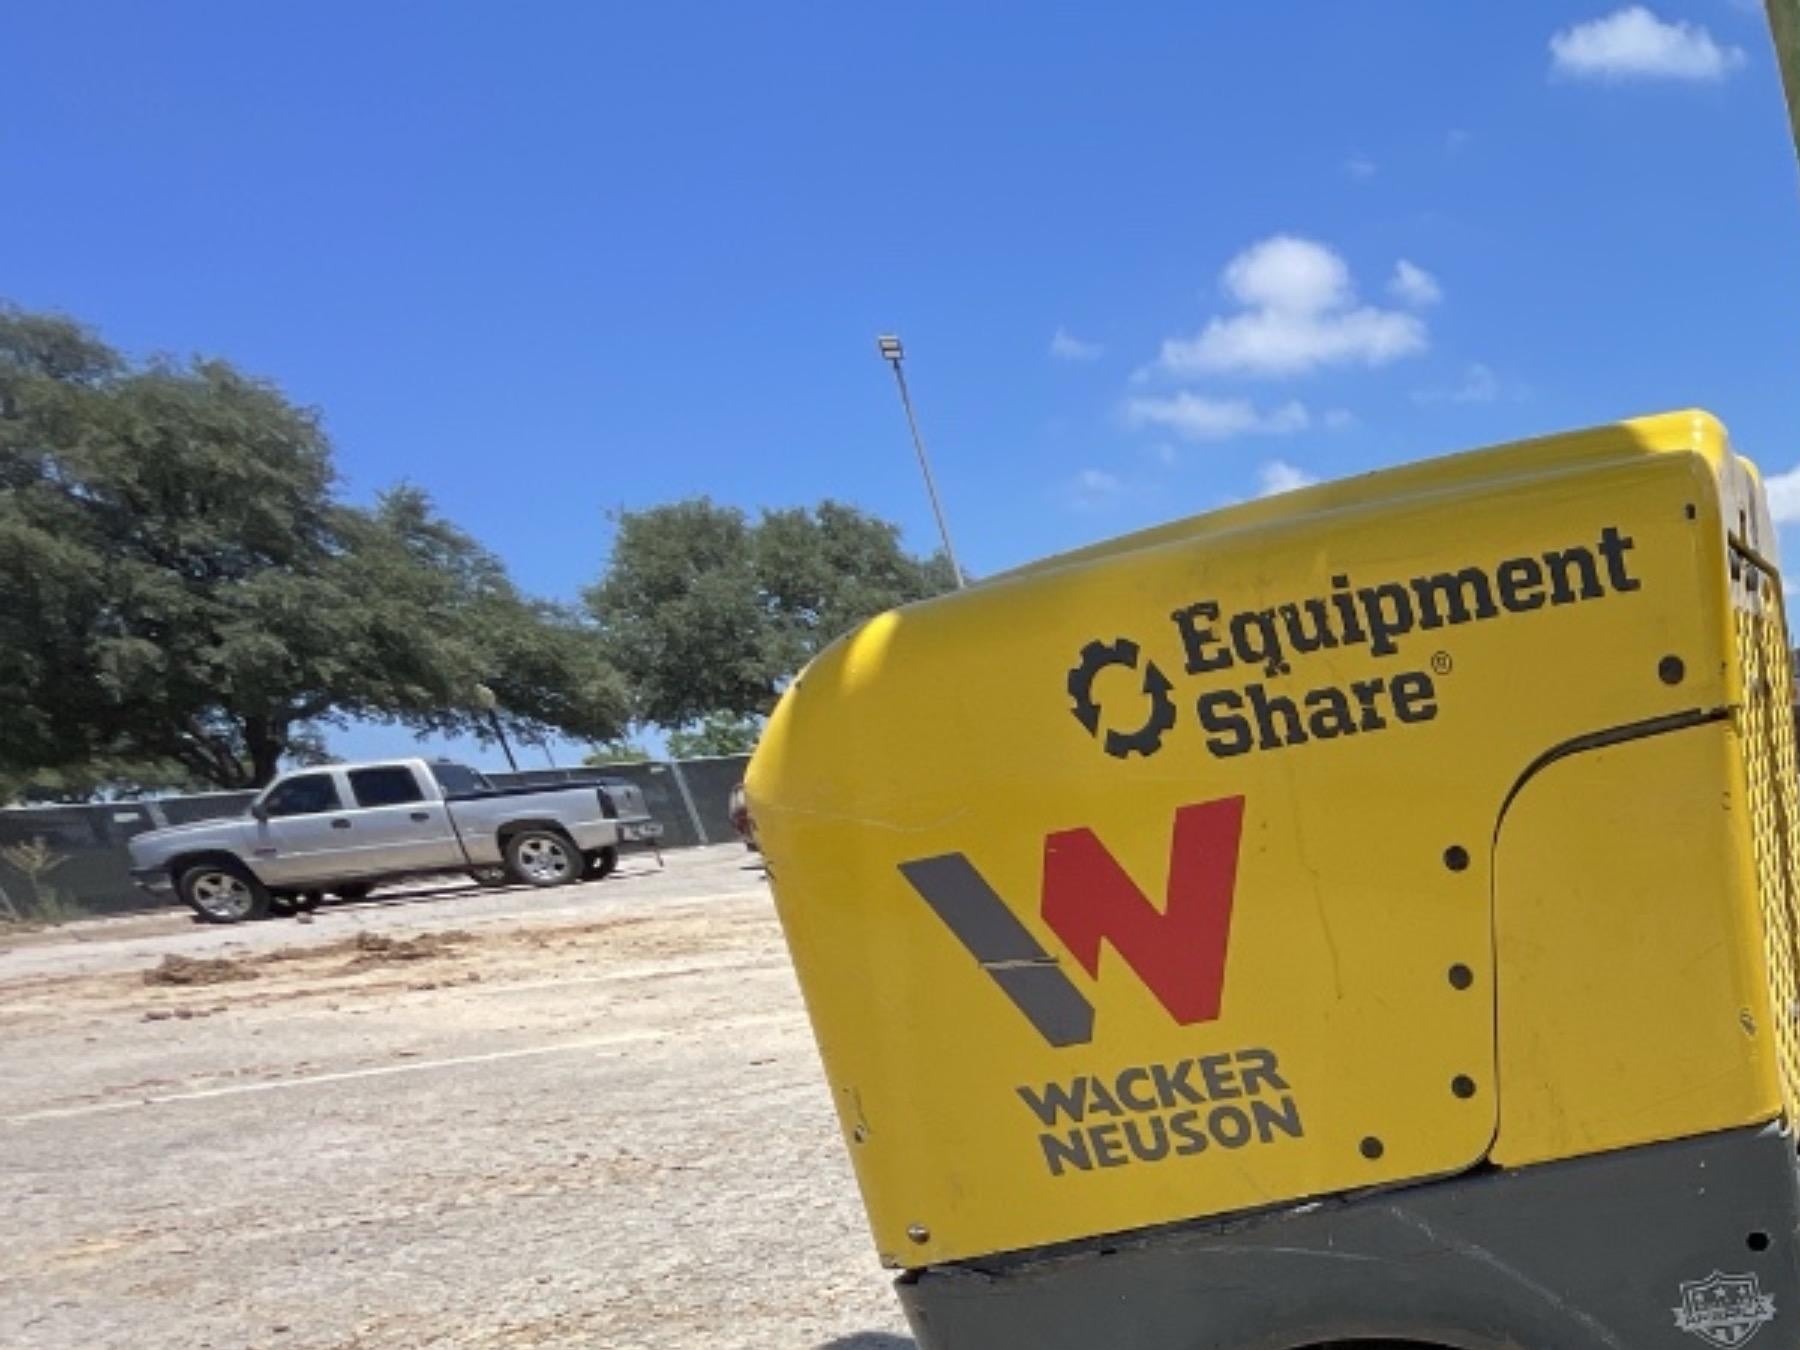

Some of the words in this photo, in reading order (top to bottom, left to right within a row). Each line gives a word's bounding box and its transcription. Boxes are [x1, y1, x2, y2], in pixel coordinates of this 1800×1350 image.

[1171, 526, 1641, 679] Equipment
[1016, 1047, 1291, 1127] WACKER
[1038, 1095, 1305, 1177] NEUSON
